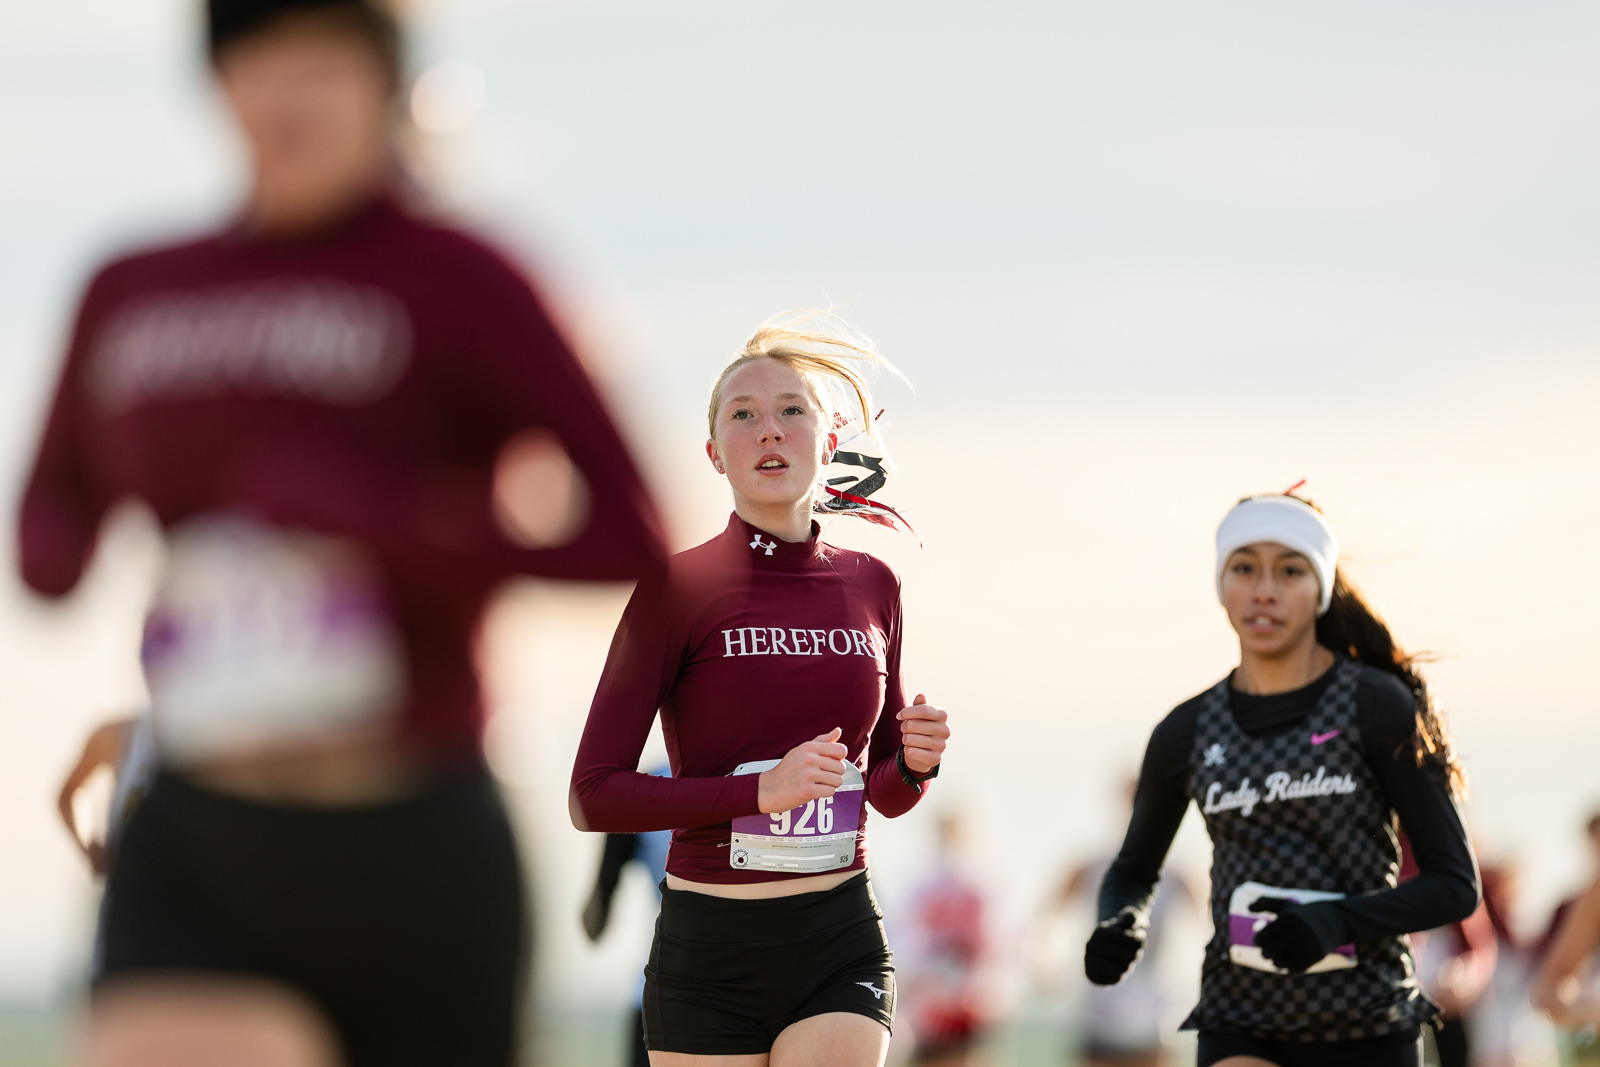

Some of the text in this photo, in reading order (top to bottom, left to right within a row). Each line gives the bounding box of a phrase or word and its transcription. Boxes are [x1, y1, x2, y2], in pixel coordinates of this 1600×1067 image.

[1203, 765, 1357, 817] Lady Raiders
[769, 796, 834, 836] 926
[839, 855, 849, 863] 926
